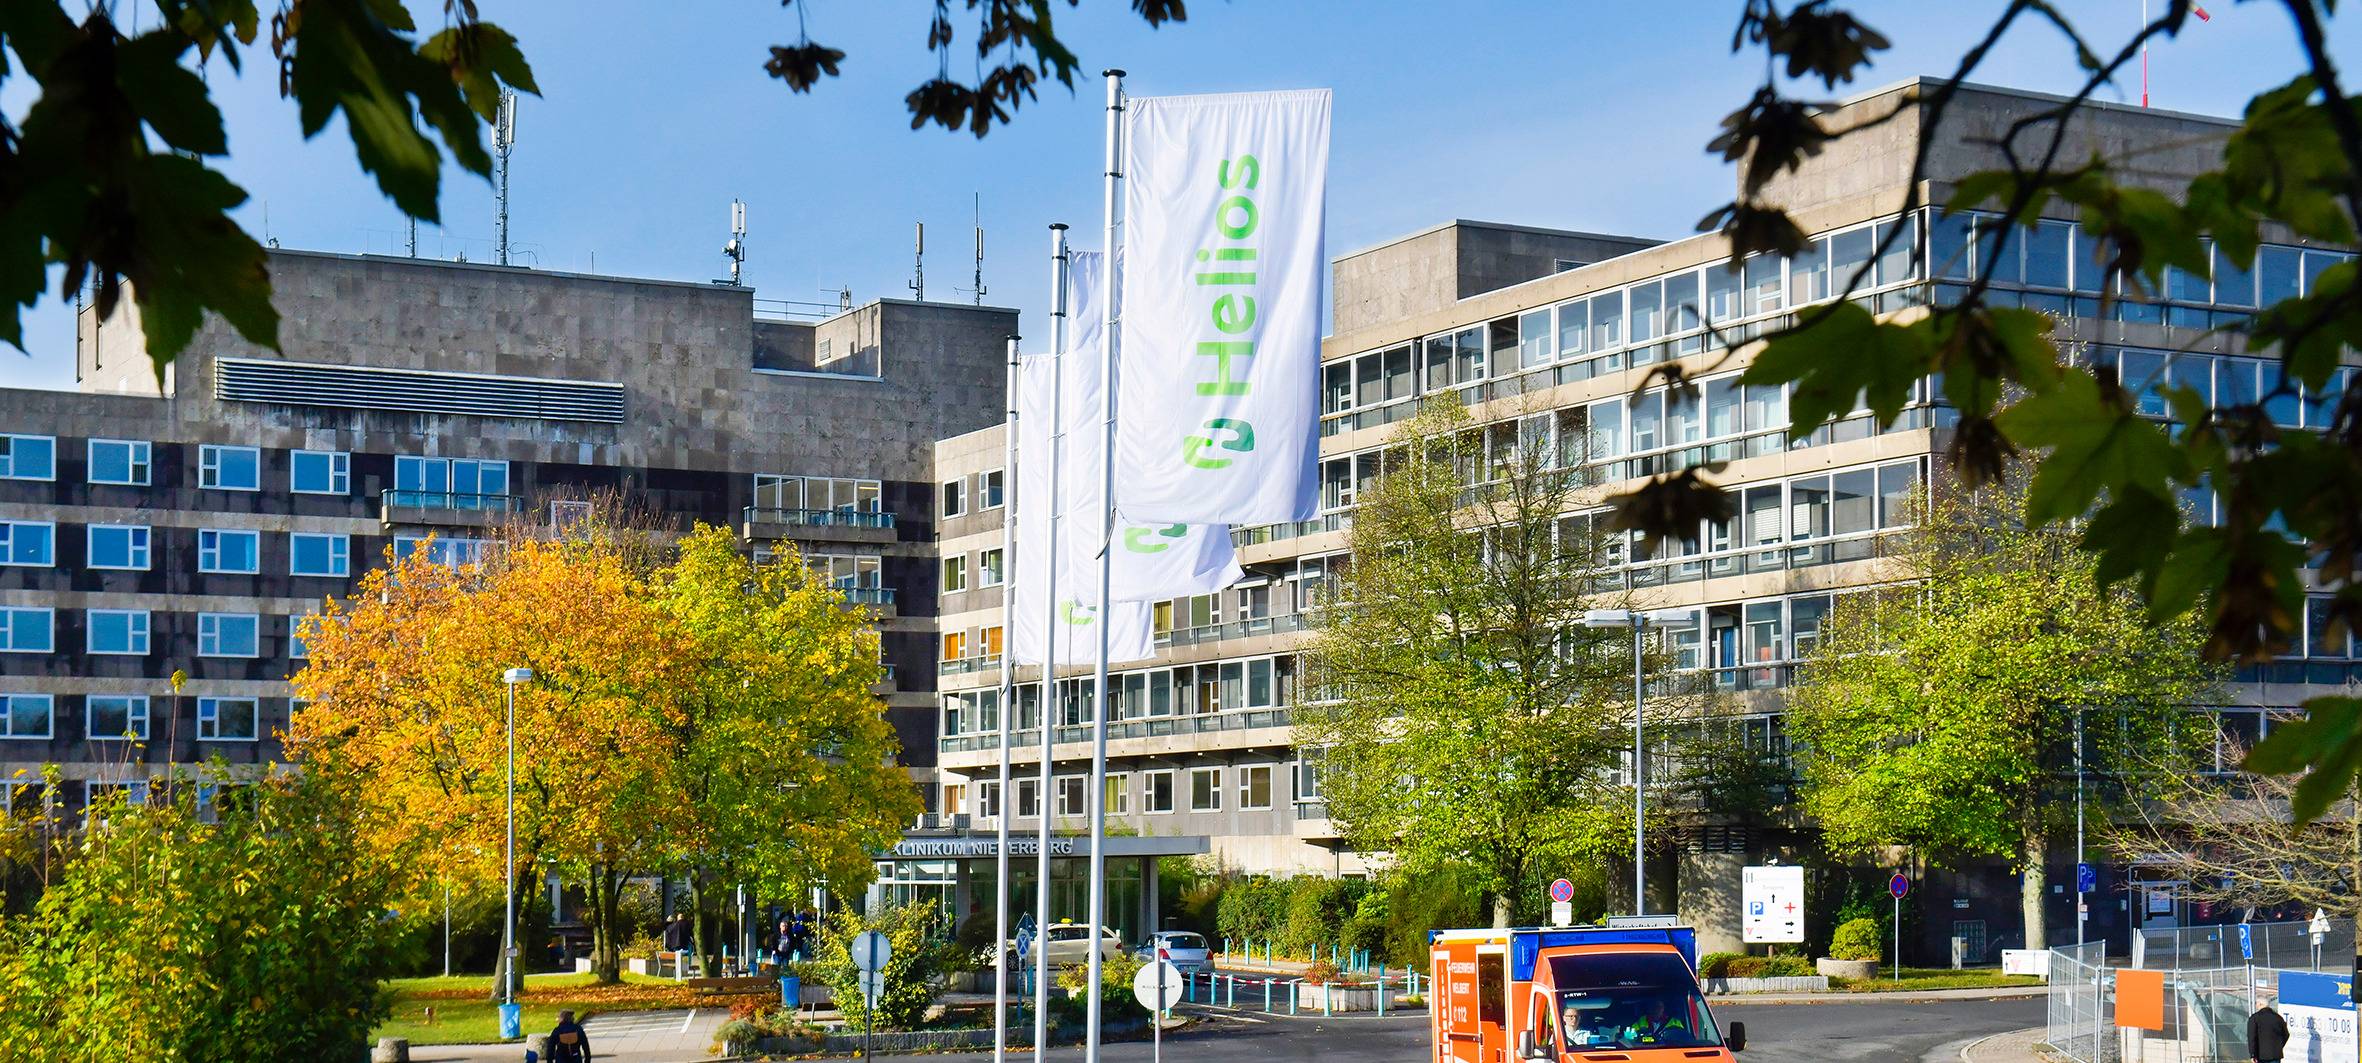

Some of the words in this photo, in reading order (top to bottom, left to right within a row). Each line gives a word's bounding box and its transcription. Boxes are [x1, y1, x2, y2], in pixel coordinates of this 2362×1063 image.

[1196, 153, 1261, 396] Helios
[893, 841, 967, 856] KLINIKUM
[971, 841, 1073, 855] NIEERBRG
